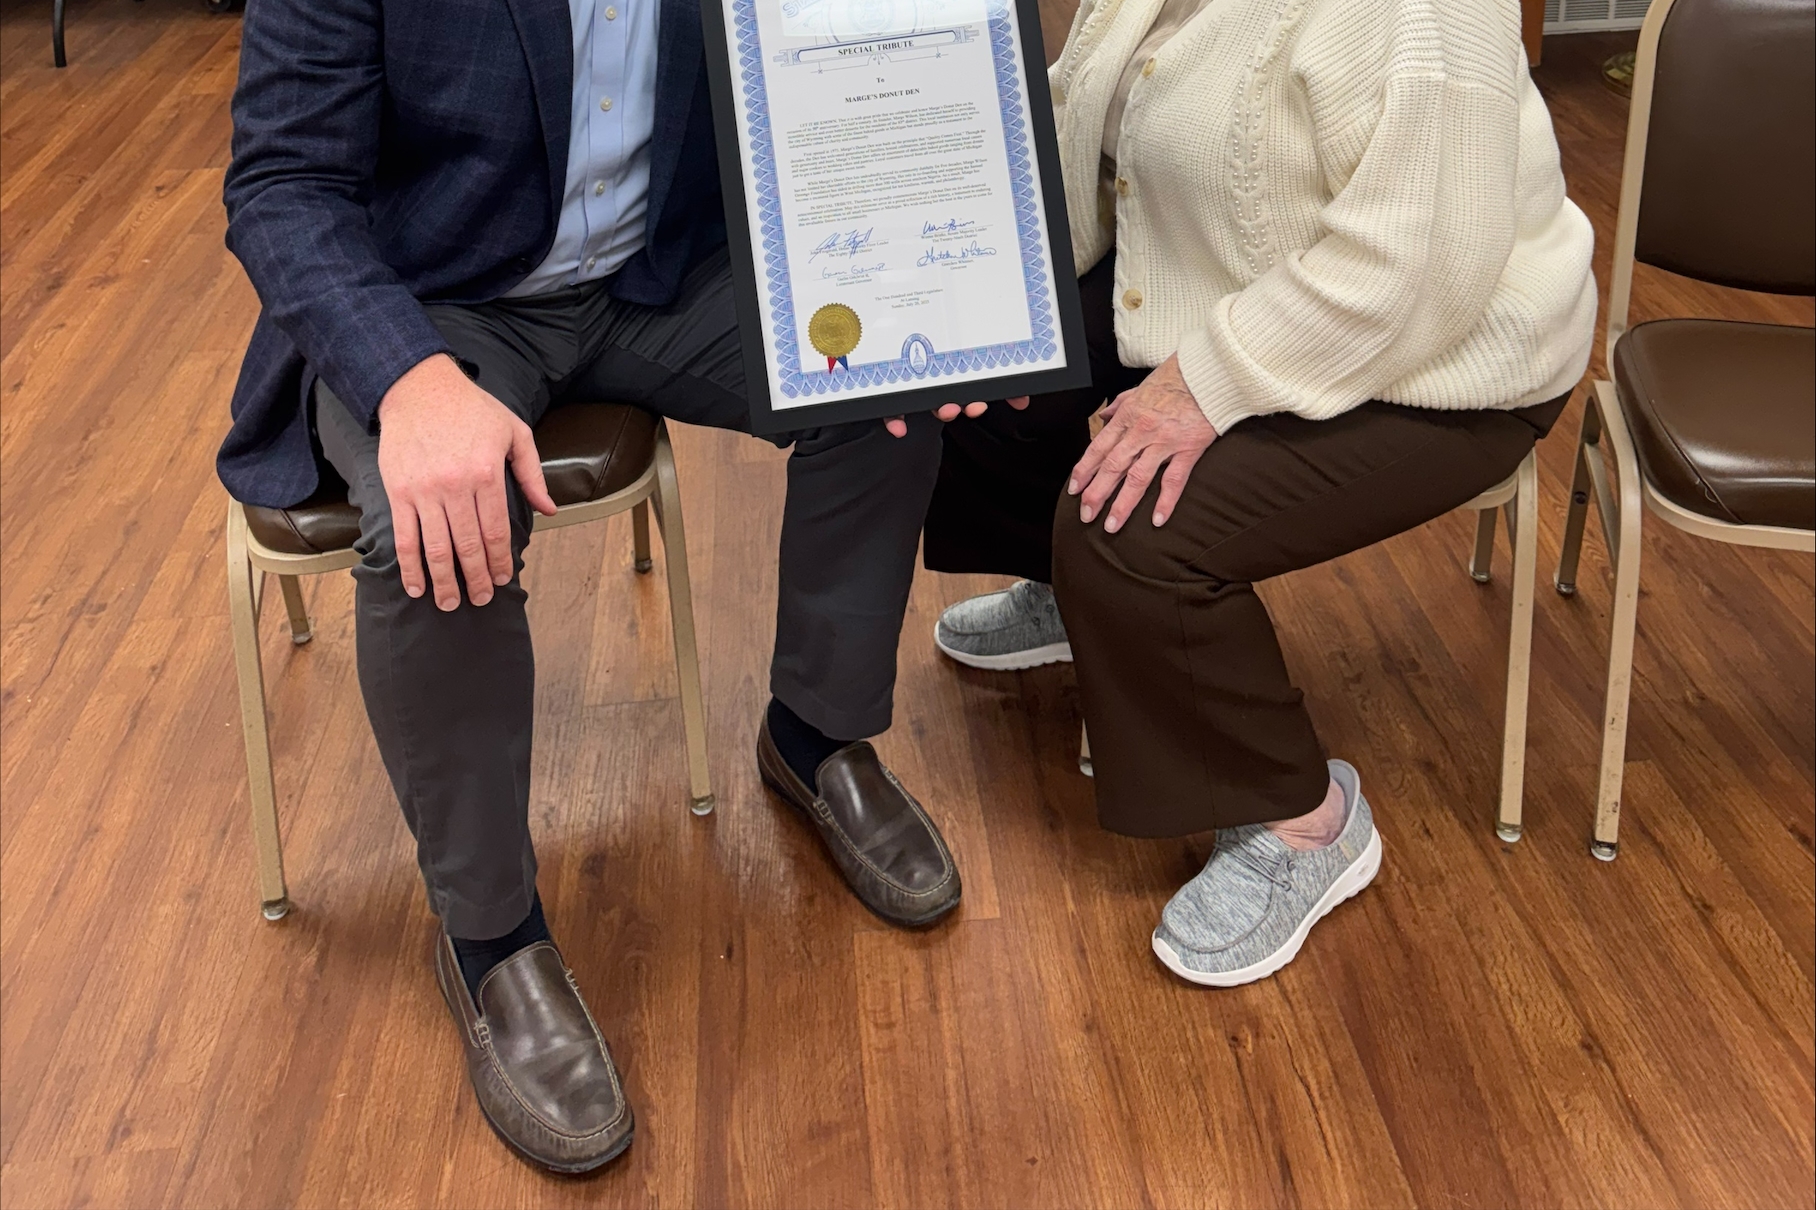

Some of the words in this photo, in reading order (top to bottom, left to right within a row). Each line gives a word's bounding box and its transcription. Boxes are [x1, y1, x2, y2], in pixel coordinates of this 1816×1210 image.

[838, 45, 873, 55] SPECIAL
[876, 40, 913, 50] TRIBUTE
[844, 93, 877, 103] MARGE'S
[879, 90, 903, 98] DONUT
